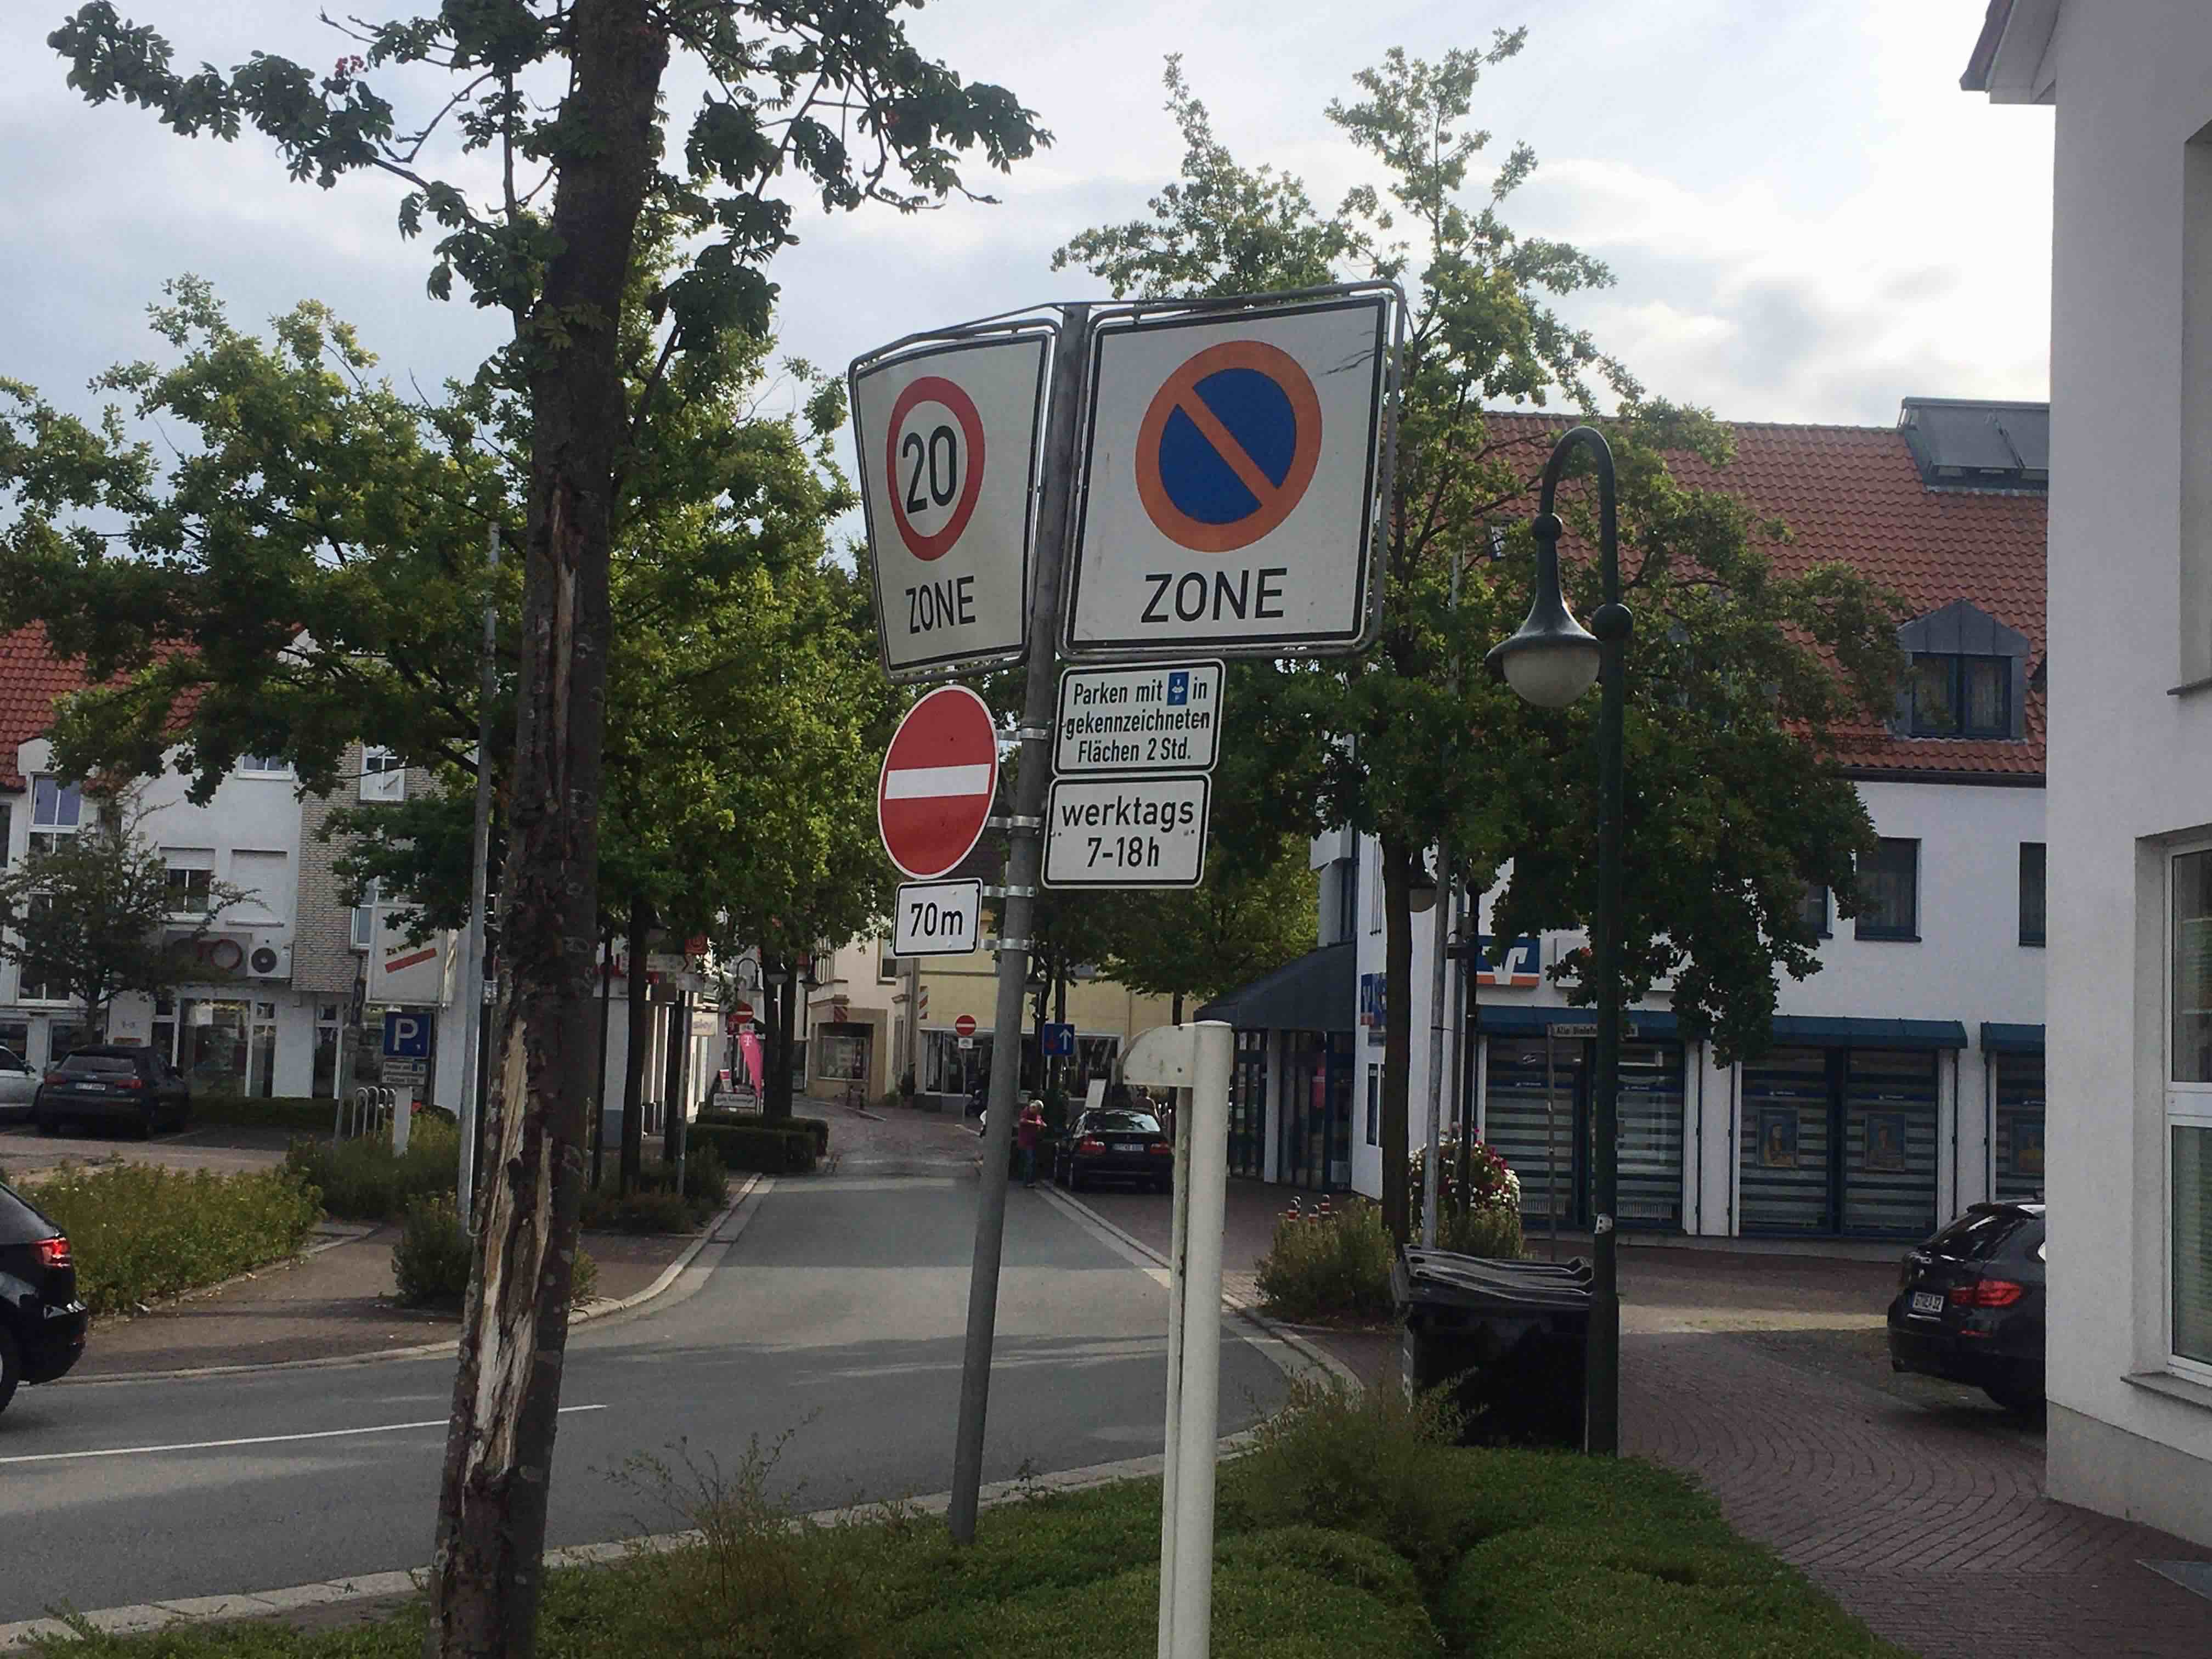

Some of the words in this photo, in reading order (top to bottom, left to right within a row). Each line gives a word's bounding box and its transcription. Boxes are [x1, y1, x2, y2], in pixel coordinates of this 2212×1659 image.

[902, 424, 957, 514] 20
[905, 574, 977, 634] ZONE
[1140, 567, 1288, 623] ZONE
[1073, 681, 1128, 706] Parken
[1135, 679, 1163, 703] mit
[1192, 676, 1207, 700] in
[1065, 708, 1210, 740] gekennzeichneten
[1077, 739, 1139, 763] Flächen
[1147, 737, 1156, 761] 2
[1160, 736, 1191, 760] Std.
[1061, 794, 1194, 833] werktags
[393, 1018, 419, 1052] P
